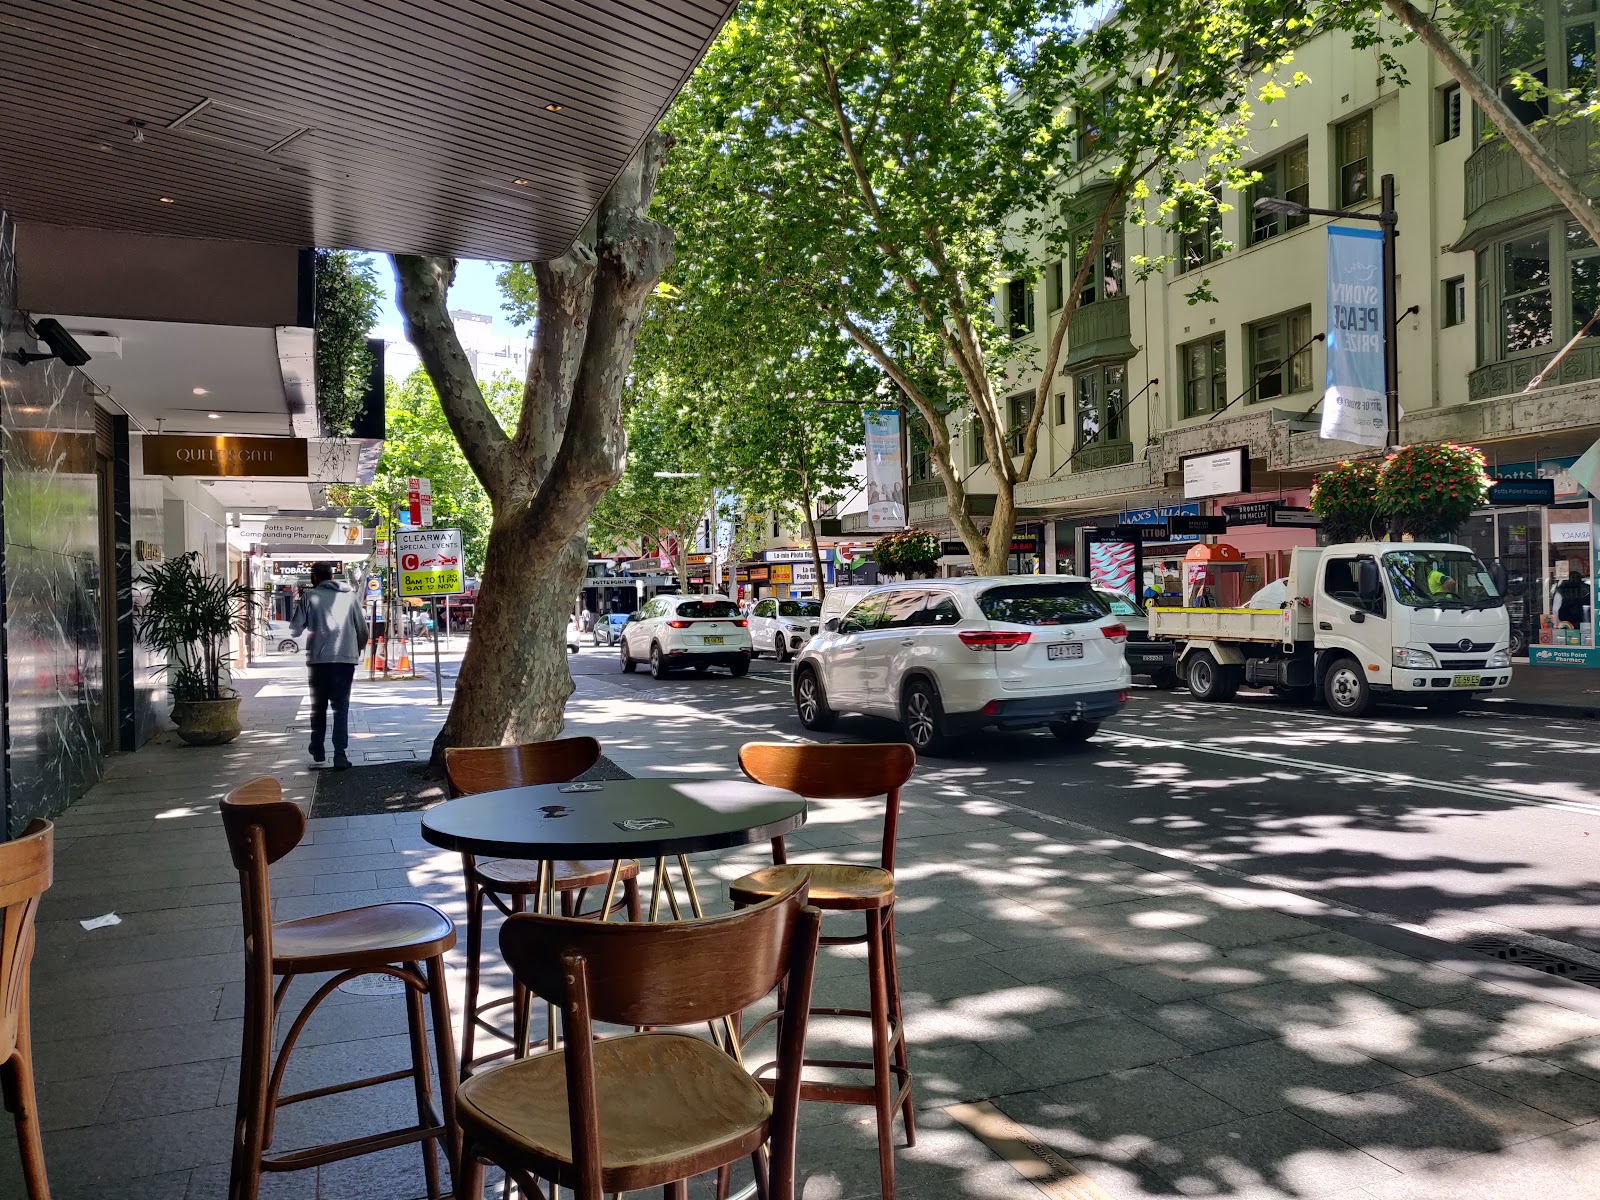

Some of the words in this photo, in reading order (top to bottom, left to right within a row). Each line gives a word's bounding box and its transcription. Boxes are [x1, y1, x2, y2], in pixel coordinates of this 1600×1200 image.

[1247, 511, 1267, 519] MACLEA
[240, 531, 292, 539] Compounding
[293, 531, 329, 540] Pharmacy
[1141, 528, 1166, 538] ATTOO
[403, 533, 453, 543] CLEARWAY
[405, 575, 422, 586] 8AM
[425, 576, 435, 584] TO
[1555, 656, 1586, 664] Pharmacy
